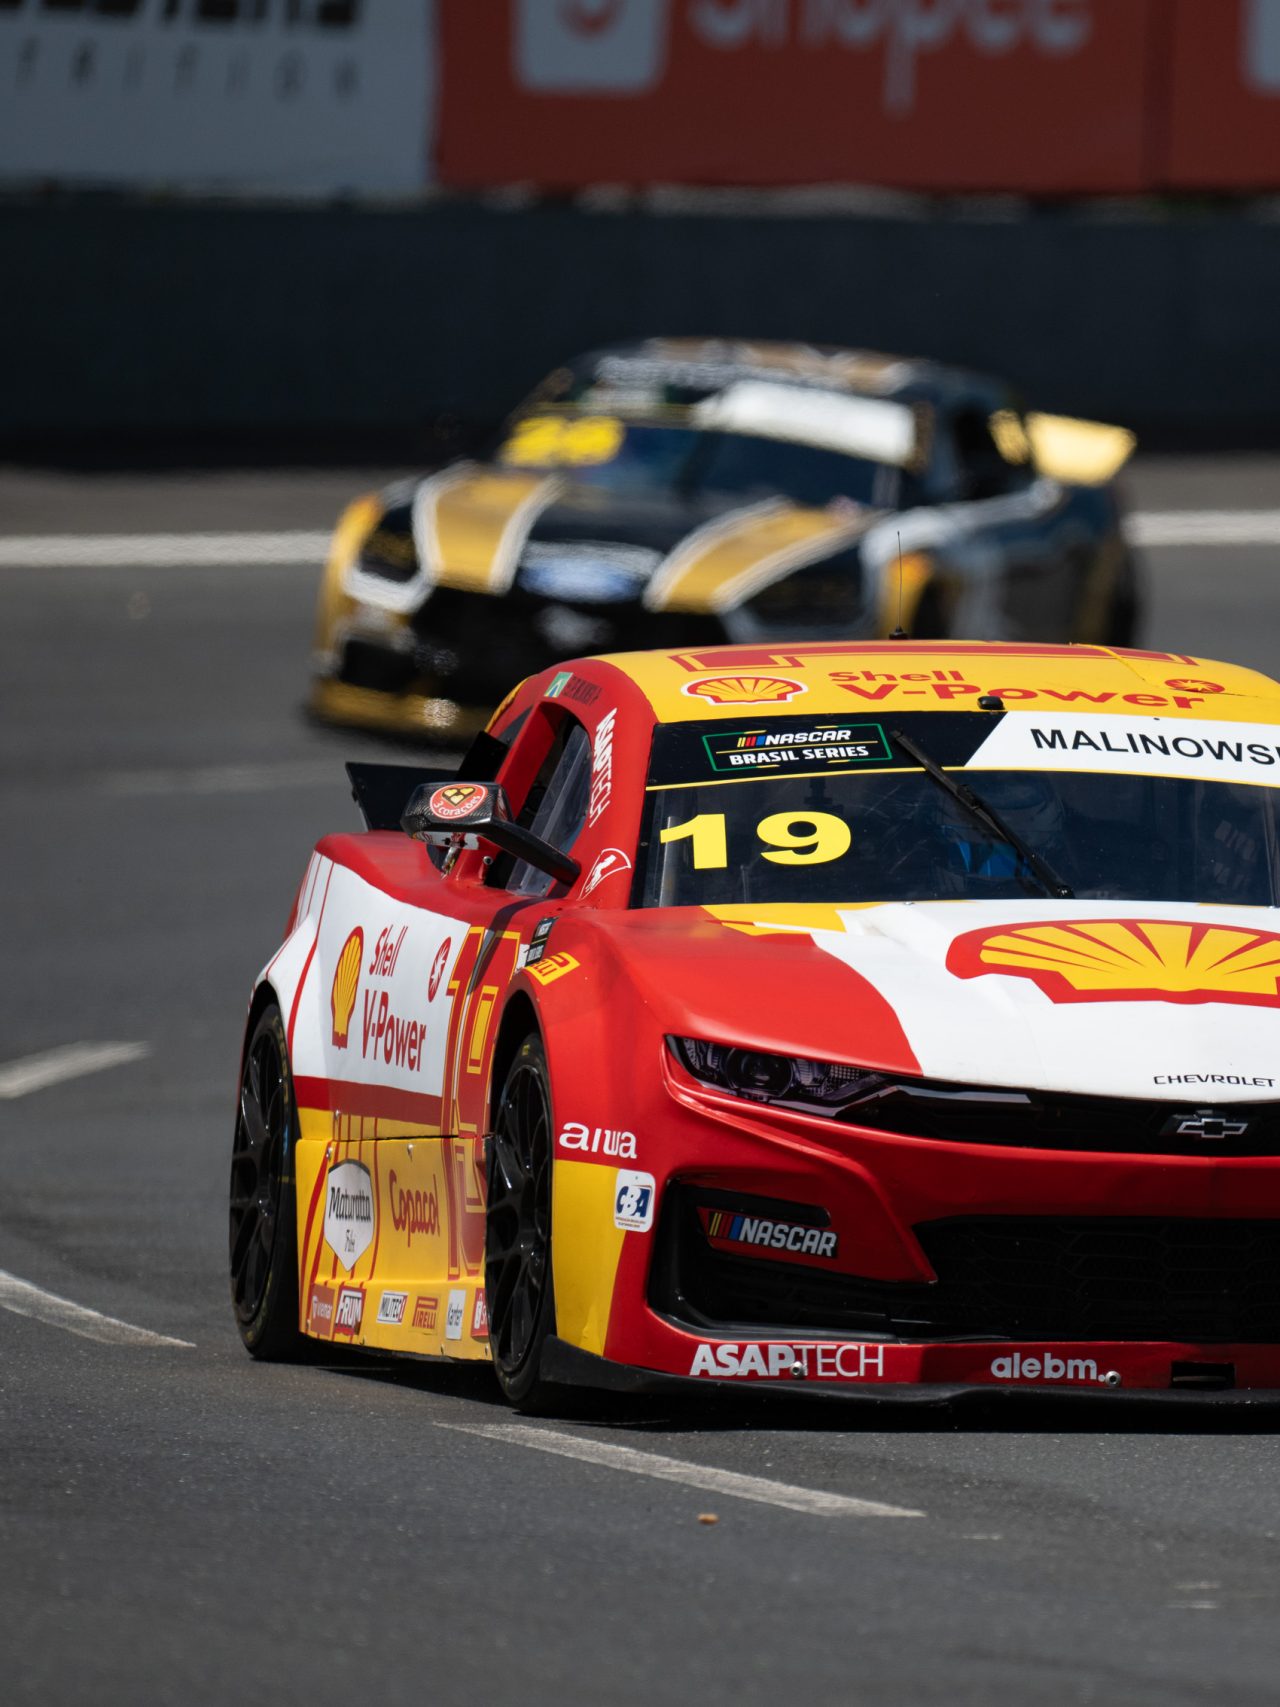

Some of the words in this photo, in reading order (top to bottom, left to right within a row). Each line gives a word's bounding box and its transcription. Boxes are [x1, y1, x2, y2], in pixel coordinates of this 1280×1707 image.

[828, 670, 967, 682] Shell
[836, 683, 1205, 710] V-Power
[764, 730, 852, 746] NASCAR
[729, 750, 799, 766] BRASIL
[802, 746, 869, 760] SERIES
[660, 811, 852, 870] 19
[369, 925, 409, 978] Shell
[362, 989, 427, 1072] V-Power
[1153, 1074, 1275, 1087] CHEVROLET
[558, 1122, 638, 1160] aiwa
[389, 1169, 441, 1248] Copacol
[616, 1185, 651, 1218] CBA
[738, 1218, 838, 1257] NASCAR
[412, 1296, 439, 1329] PIRELLI
